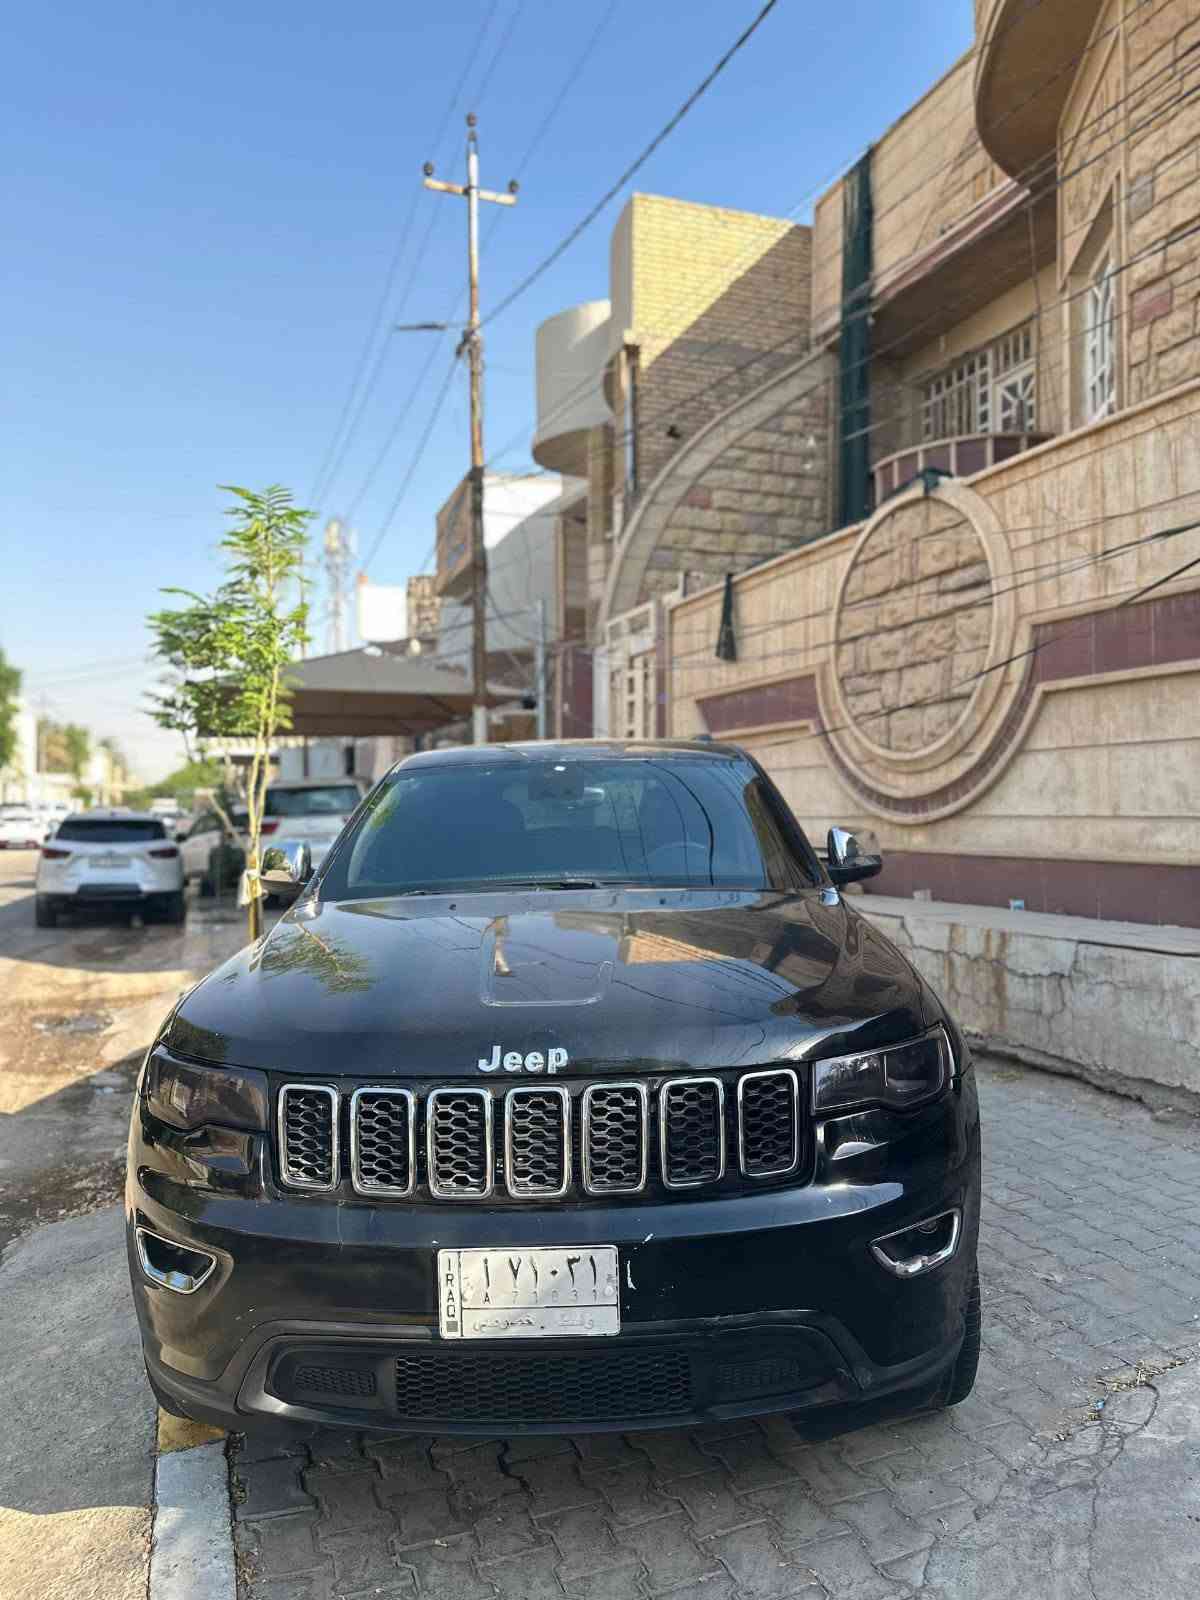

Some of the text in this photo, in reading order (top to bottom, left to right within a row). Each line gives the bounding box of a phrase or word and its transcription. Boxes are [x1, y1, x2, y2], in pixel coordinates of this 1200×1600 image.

[478, 1045, 569, 1074] Jeep
[446, 1257, 456, 1318] IRAQ
[483, 1291, 491, 1304] A
